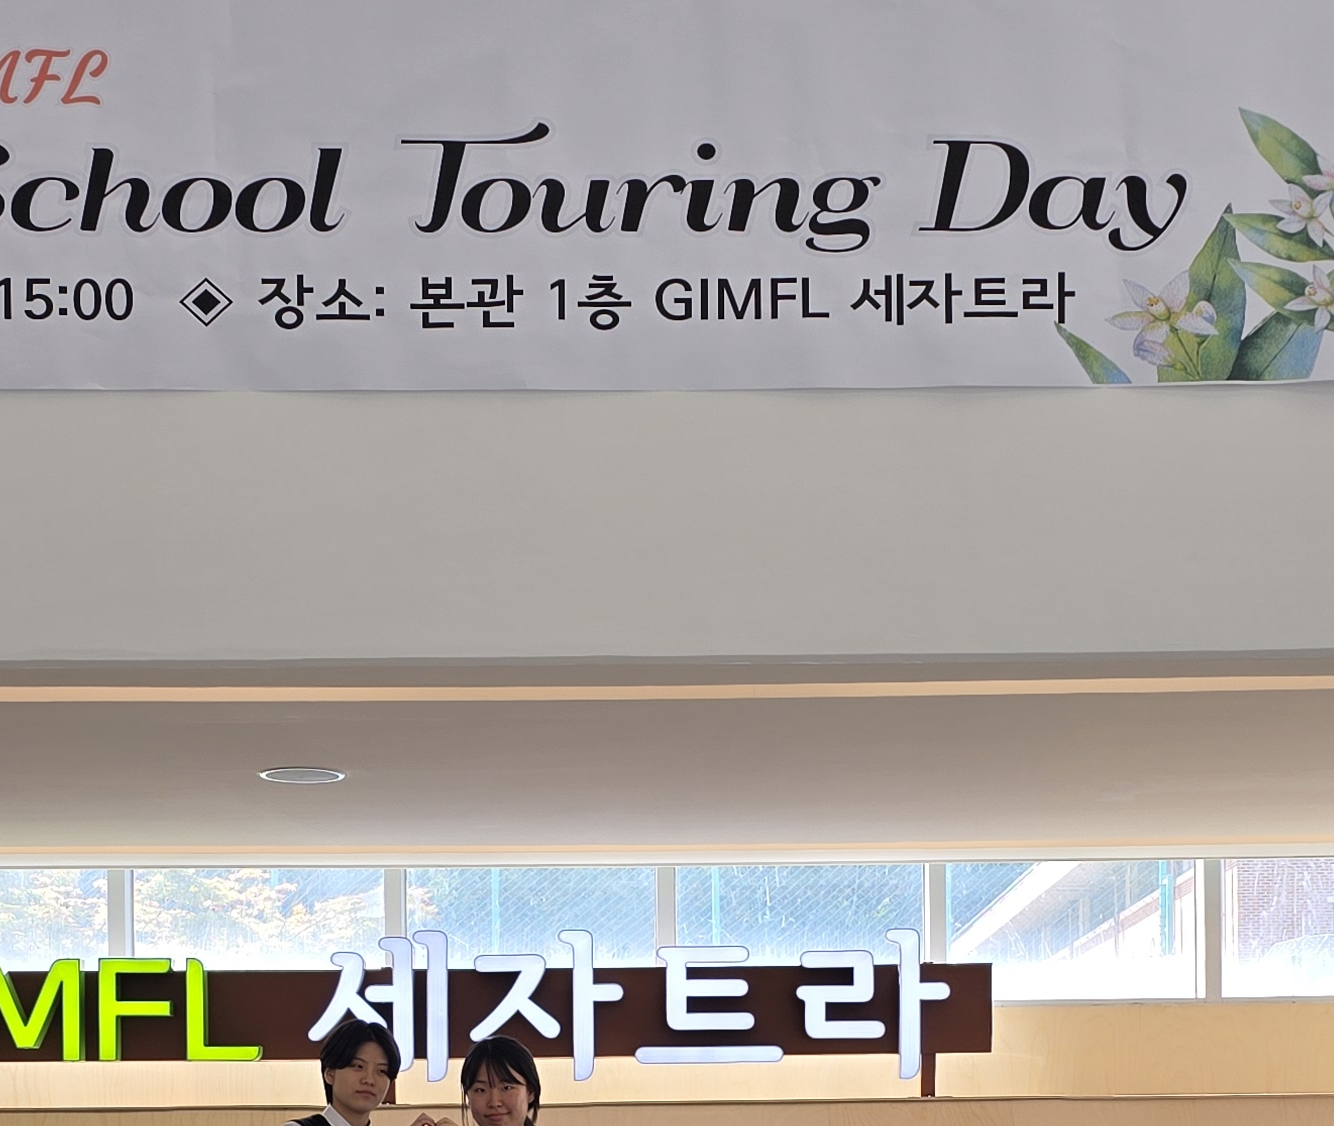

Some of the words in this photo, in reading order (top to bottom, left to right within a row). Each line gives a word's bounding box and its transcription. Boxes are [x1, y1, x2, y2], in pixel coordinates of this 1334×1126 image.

[400, 122, 881, 253] Touring
[918, 140, 1188, 252] Day
[257, 274, 385, 330] 장소:
[409, 274, 524, 329] 본관
[549, 274, 633, 331] 1층
[655, 277, 830, 321] GIMFL
[850, 272, 1076, 328] 세자트라
[307, 928, 952, 1083] 세자트라
